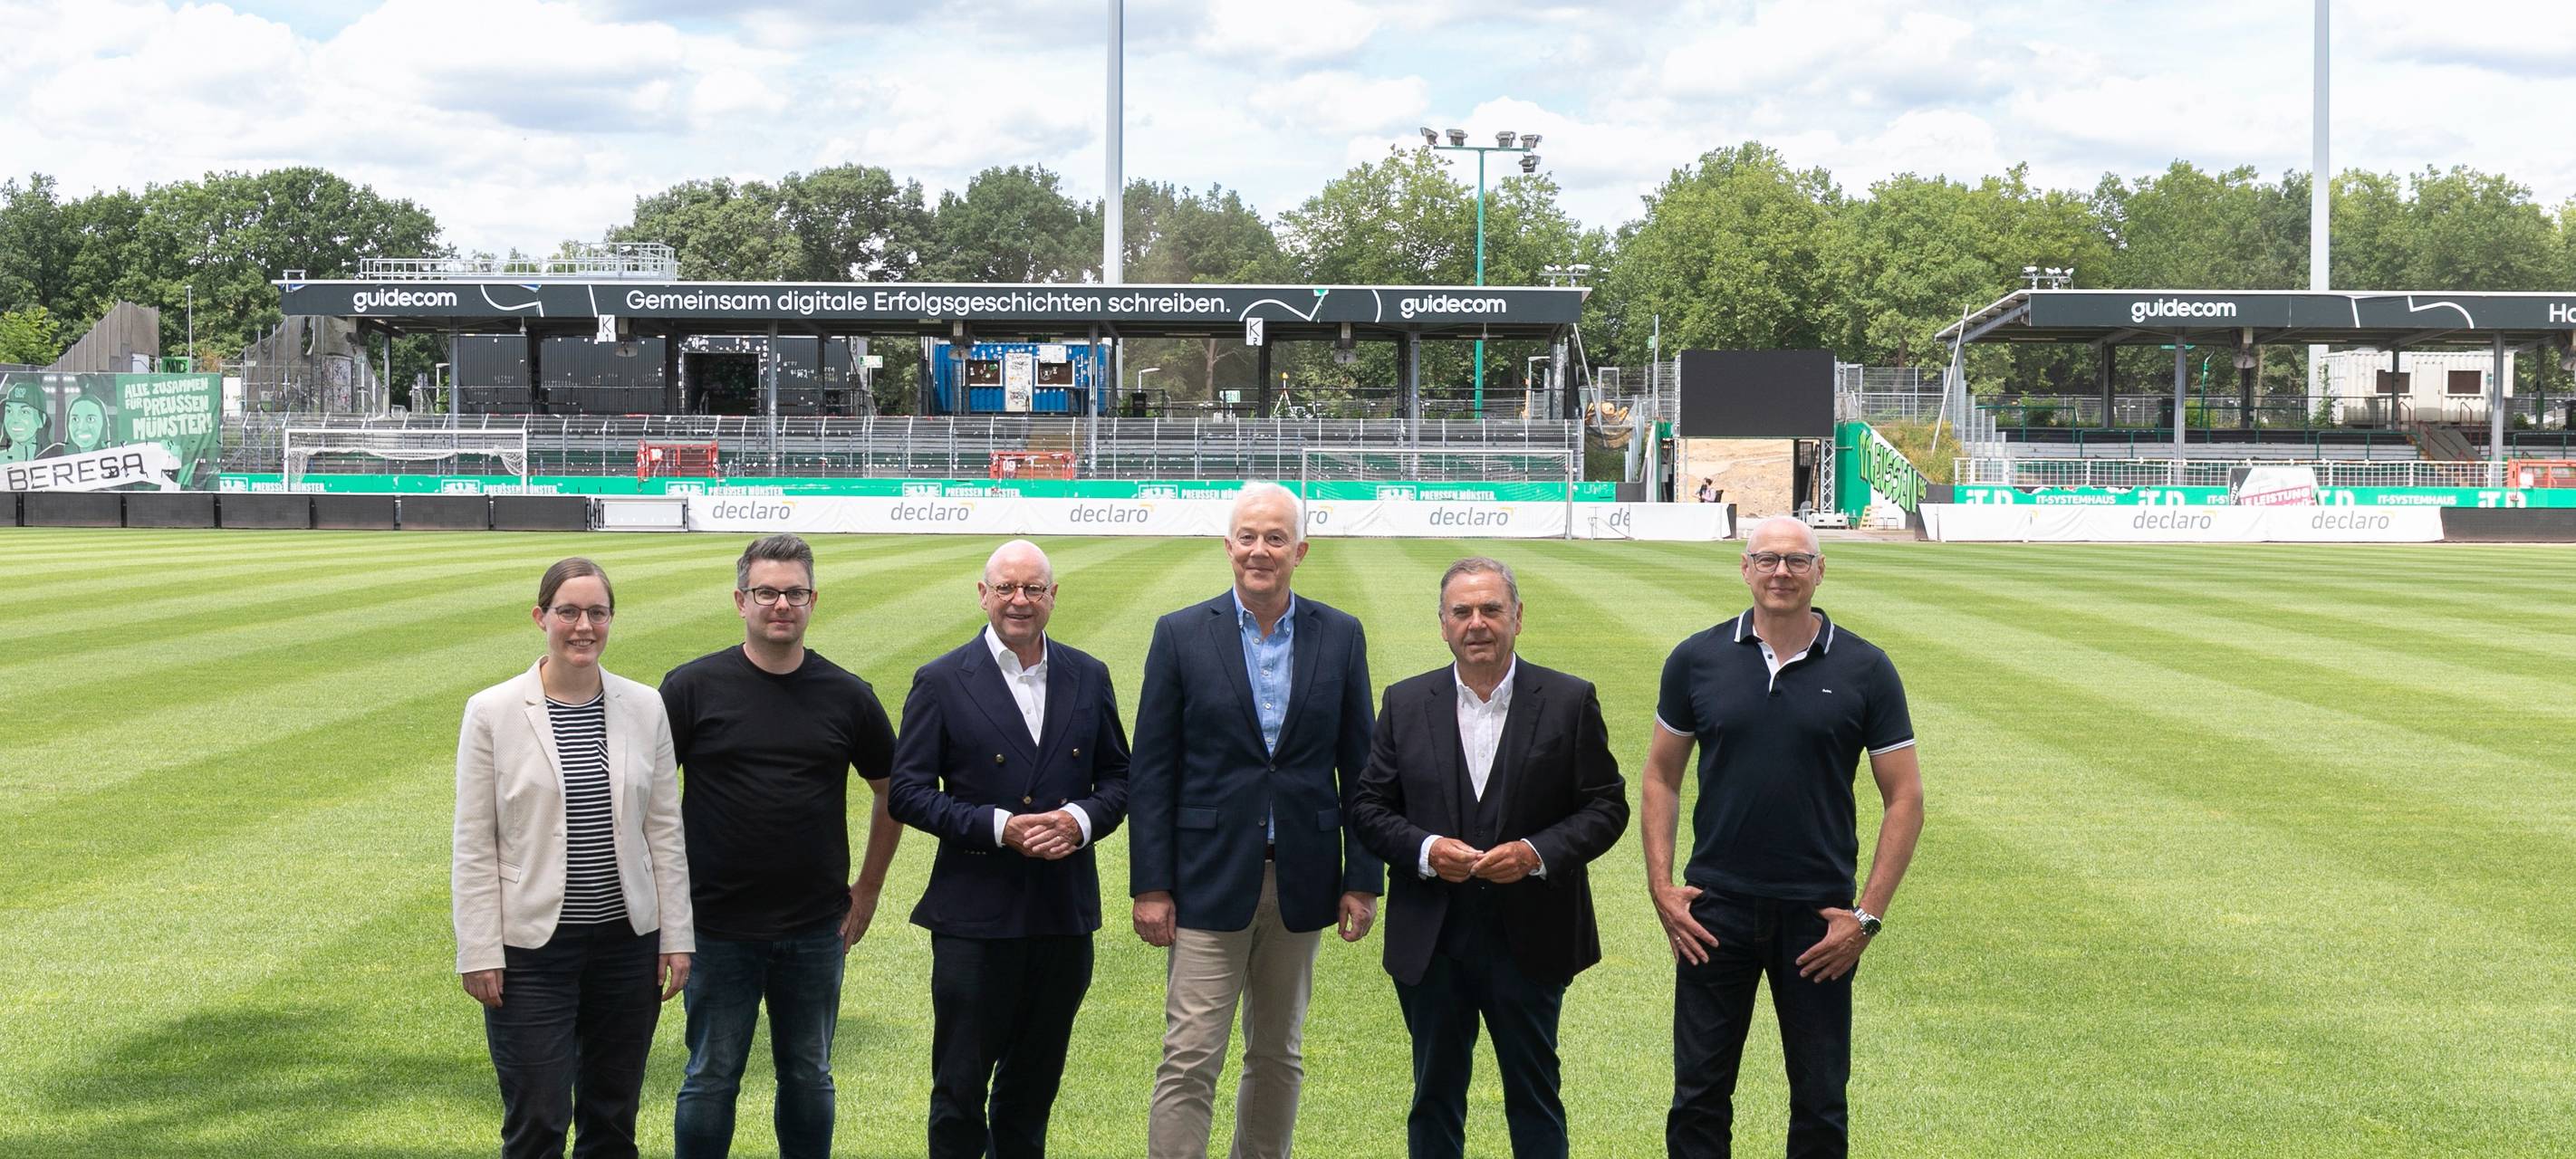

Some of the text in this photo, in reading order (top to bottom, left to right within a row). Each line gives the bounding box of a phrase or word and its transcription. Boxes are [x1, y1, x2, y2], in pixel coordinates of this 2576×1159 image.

[352, 288, 457, 313] guidecom
[626, 290, 1232, 318] Gemeinsam digitale Erfolgsgeschichten schreiben.
[1399, 294, 1507, 320] guidecom
[2130, 298, 2237, 323] guidecom
[601, 317, 612, 333] K
[1249, 320, 1262, 337] K
[124, 378, 208, 398] ALLE ZUSAMMEN
[142, 395, 209, 417] PREUSSEN
[132, 412, 213, 440] MÜNSTER!
[6, 453, 145, 492] BERESA
[251, 482, 288, 493] PREUSSE
[2035, 494, 2116, 504] IT-SYSTEMHAUS
[2377, 493, 2456, 505] IT-SYSTEMHAUS
[713, 501, 791, 520] declaro
[890, 503, 969, 521] declaro
[1070, 503, 1149, 523] declaro
[1429, 507, 1509, 526] declaro
[2133, 510, 2211, 530] declaro
[2312, 511, 2390, 530] declaro
